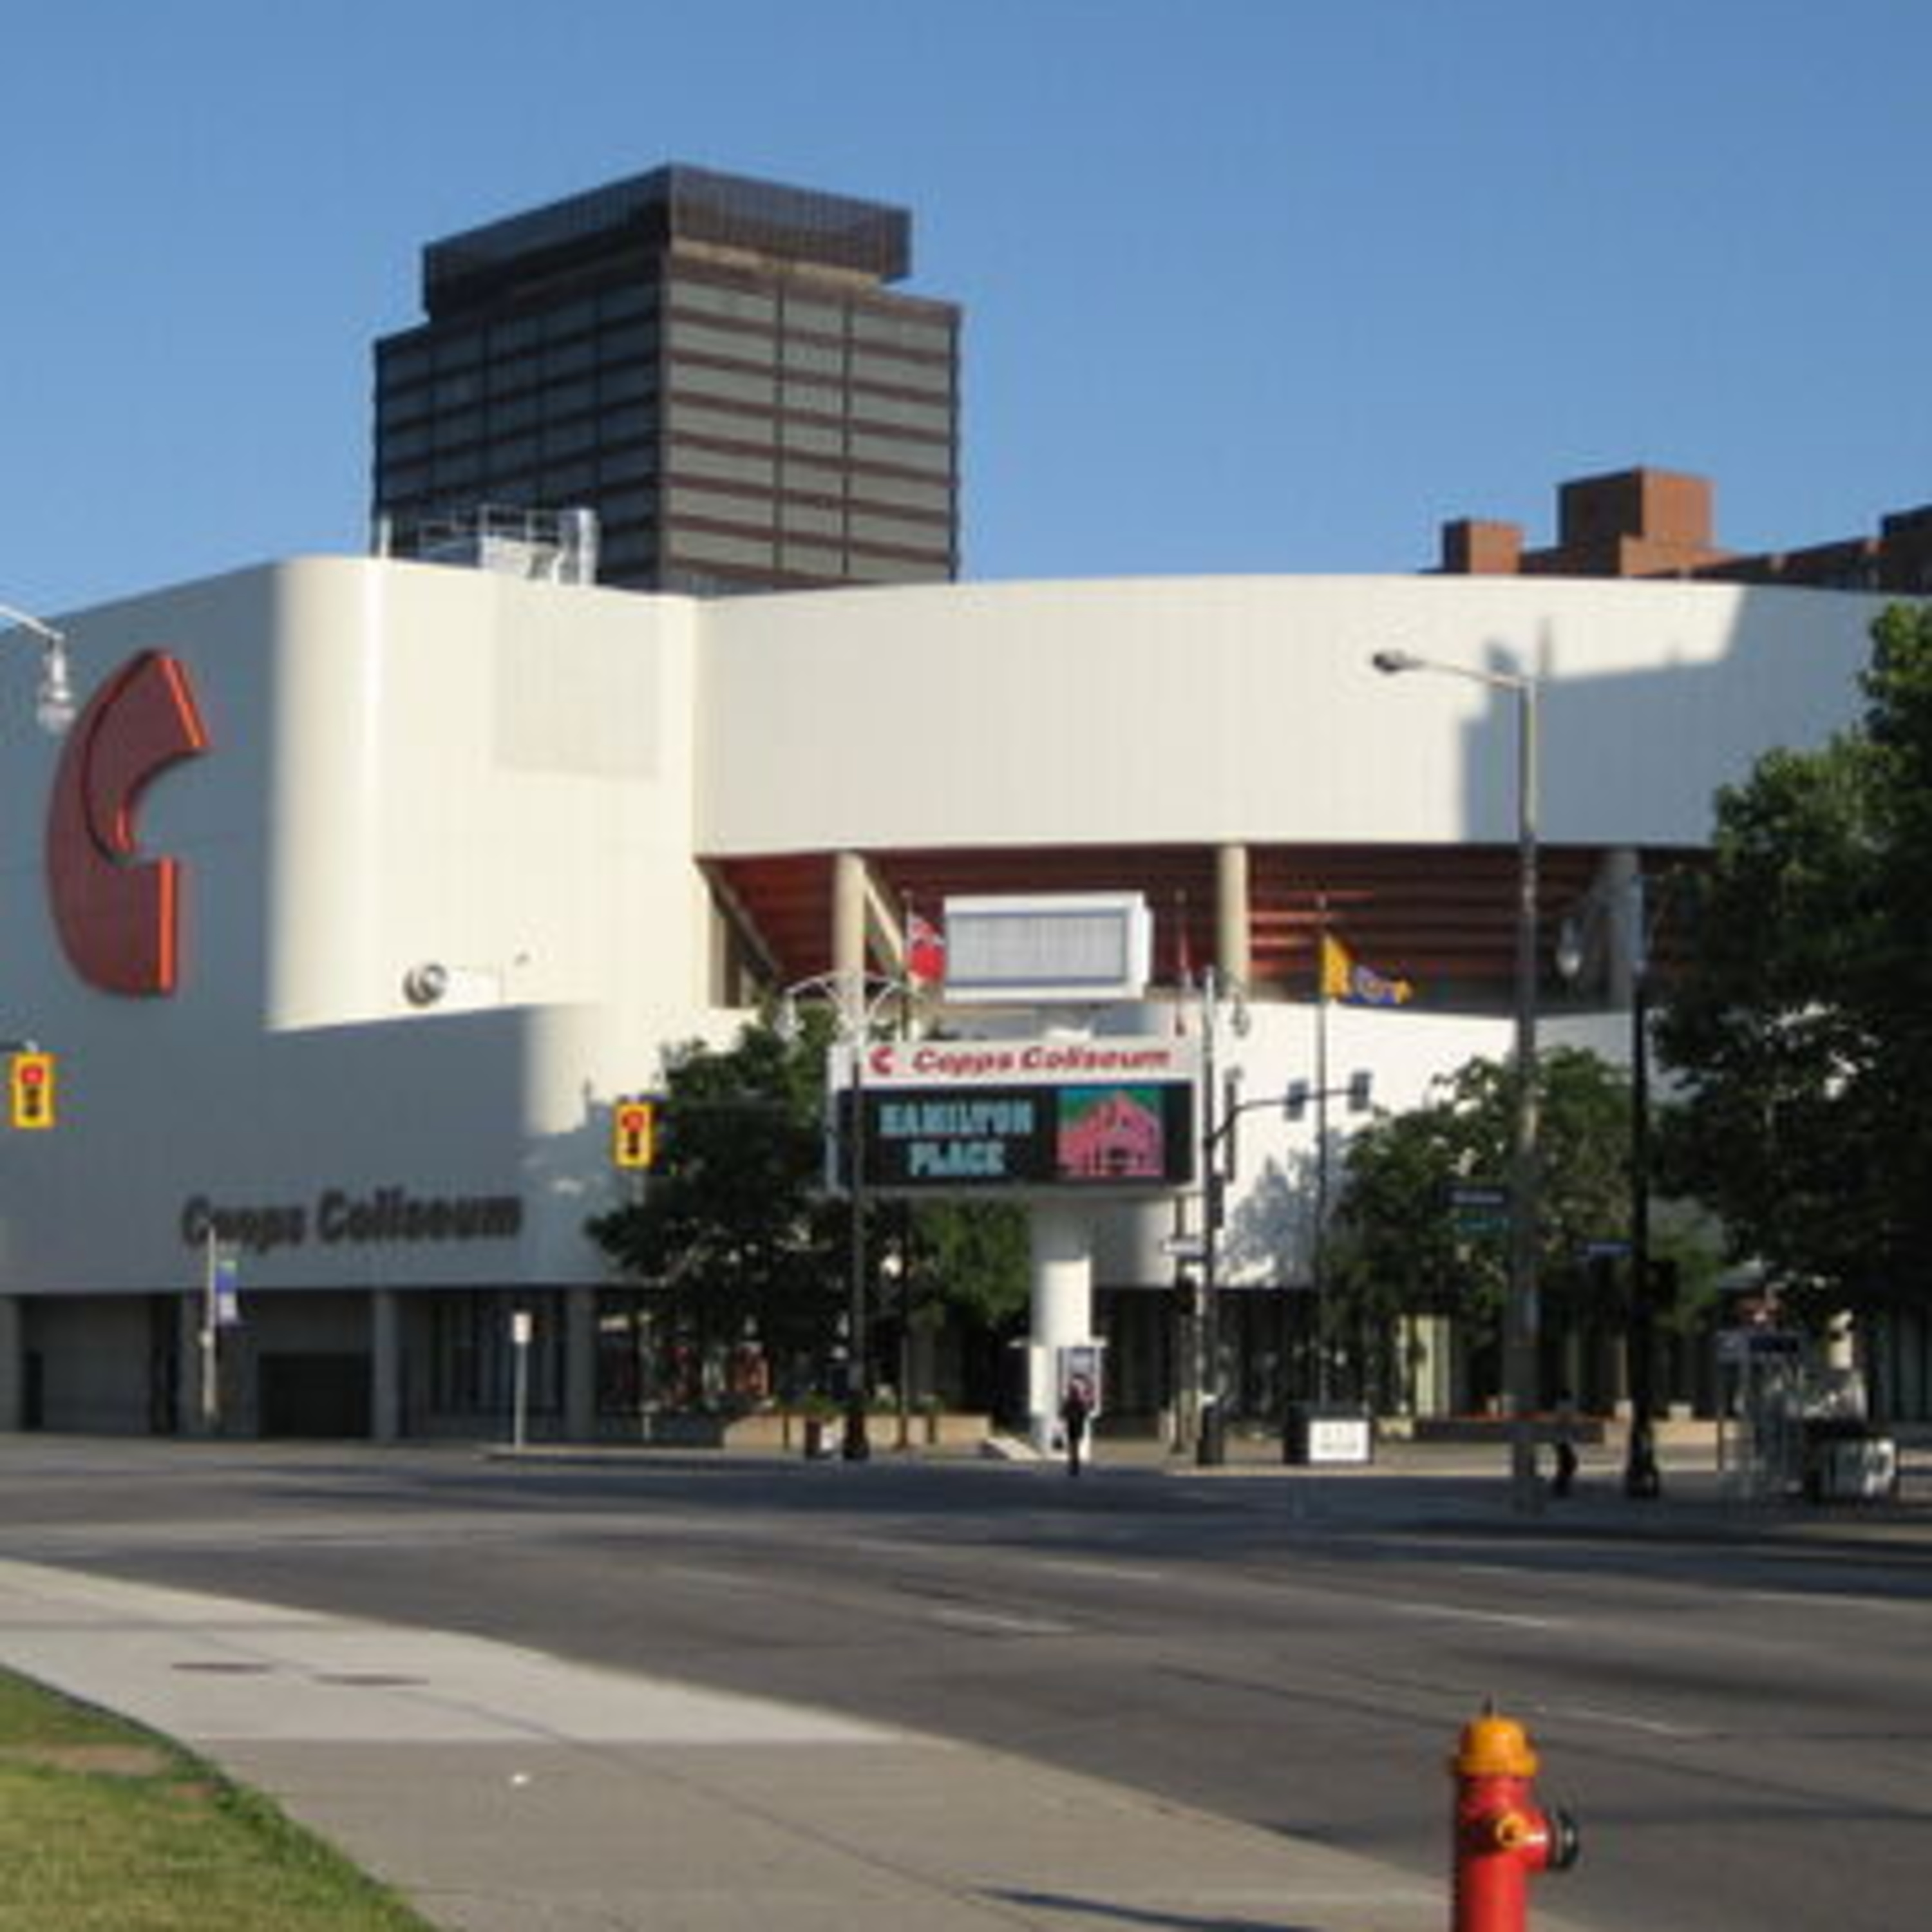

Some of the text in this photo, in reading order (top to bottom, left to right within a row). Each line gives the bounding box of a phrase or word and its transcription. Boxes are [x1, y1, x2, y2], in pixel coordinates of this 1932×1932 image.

[912, 1046, 1014, 1074] Copps
[1019, 1045, 1170, 1070] Coliseum
[879, 1101, 1033, 1133] HAMILTON
[910, 1141, 1005, 1176] PLACE
[318, 1185, 523, 1244] Coliseum
